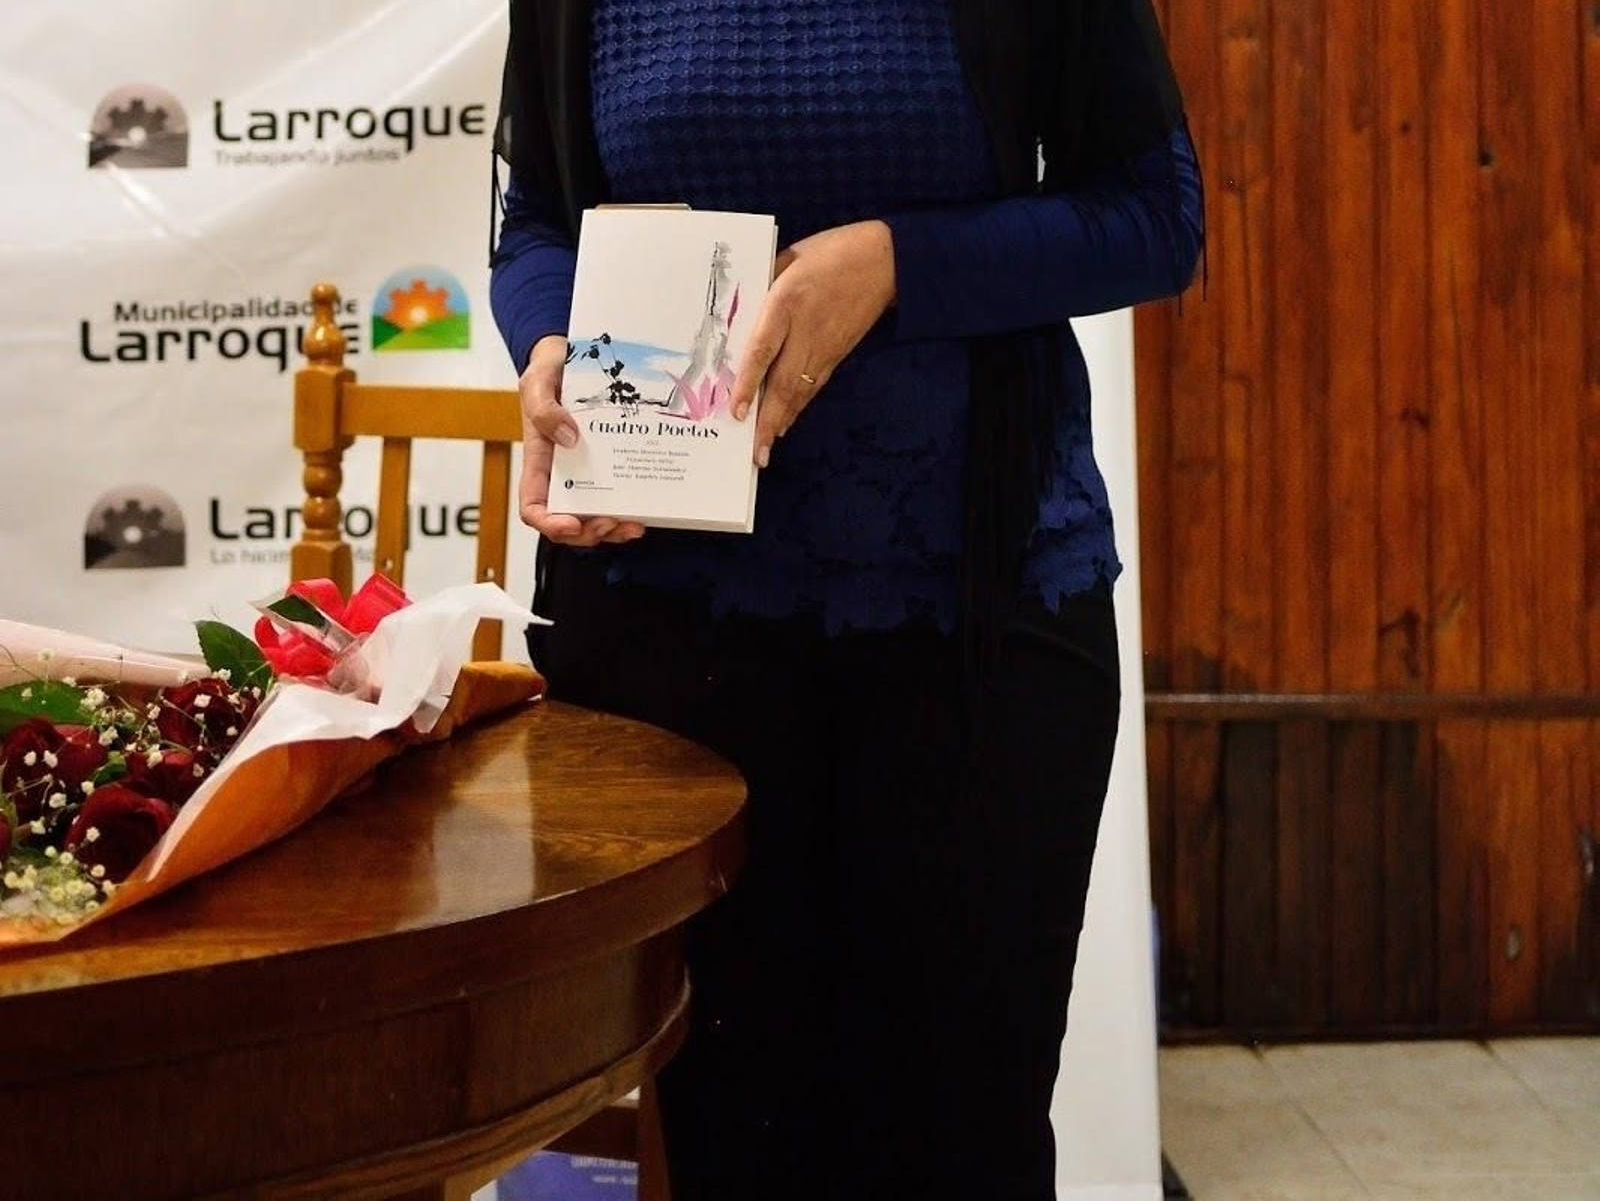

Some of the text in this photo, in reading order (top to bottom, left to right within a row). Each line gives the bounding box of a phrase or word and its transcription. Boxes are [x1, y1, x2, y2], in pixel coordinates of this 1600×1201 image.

[213, 100, 486, 154] Larroque
[588, 419, 720, 439] Cuatro Poetas
[209, 497, 481, 553] Laroue
